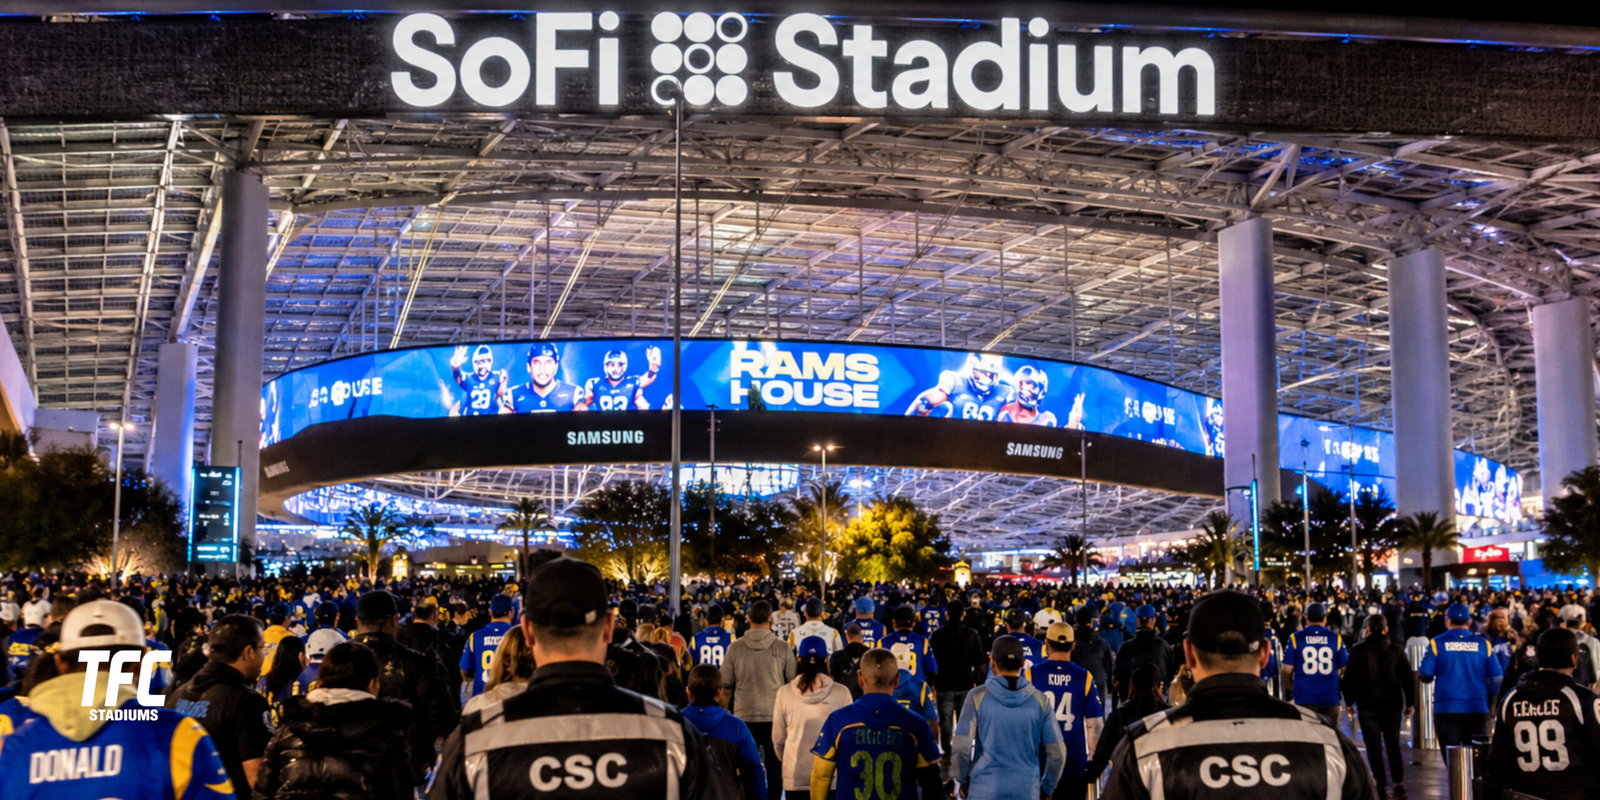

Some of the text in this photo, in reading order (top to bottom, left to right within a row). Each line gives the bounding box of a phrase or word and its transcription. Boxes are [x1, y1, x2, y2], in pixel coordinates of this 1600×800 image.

[391, 11, 1216, 116] SoFi Stadium
[730, 349, 880, 382] RAMS
[730, 379, 880, 409] HOUSE
[567, 430, 644, 446] SAMSUNG
[1006, 442, 1064, 460] SAMSUNG
[1302, 646, 1333, 675] 88
[1048, 673, 1072, 687] KUPP
[1514, 719, 1570, 772] 99
[29, 744, 123, 784] DONALD
[529, 752, 629, 792] CSC
[850, 750, 902, 800] 30
[1199, 753, 1292, 789] CSC
